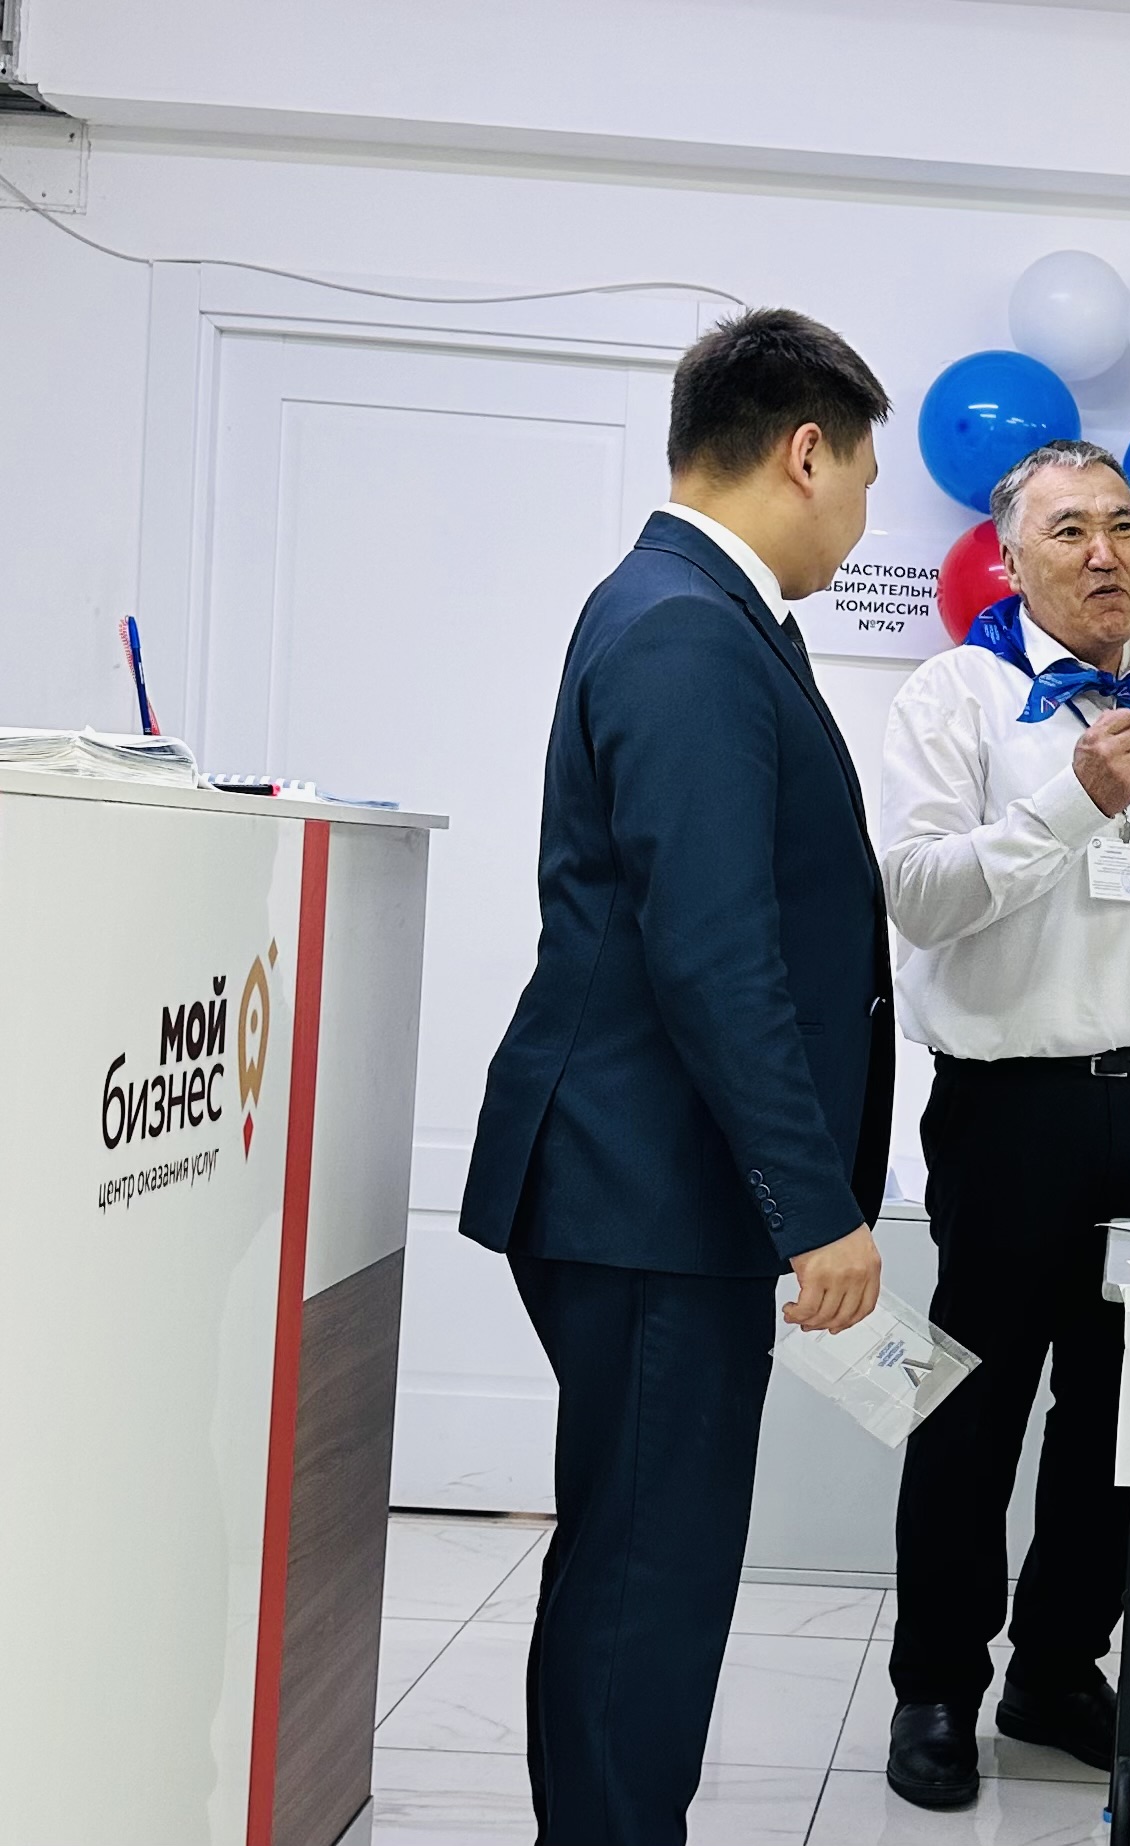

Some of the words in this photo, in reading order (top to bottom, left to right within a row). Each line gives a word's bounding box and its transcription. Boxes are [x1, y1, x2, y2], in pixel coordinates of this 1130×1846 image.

[839, 562, 940, 580] ЧАСТКОВАЯ
[825, 580, 938, 599] БИРАТЕЛЬН
[835, 599, 929, 617] КОМИССИЯ
[858, 618, 905, 633] №747
[160, 975, 227, 1066] мой
[102, 1051, 224, 1150] бизнес
[98, 1173, 135, 1215] центр
[137, 1157, 189, 1195] оказания
[191, 1148, 219, 1188] услуг
